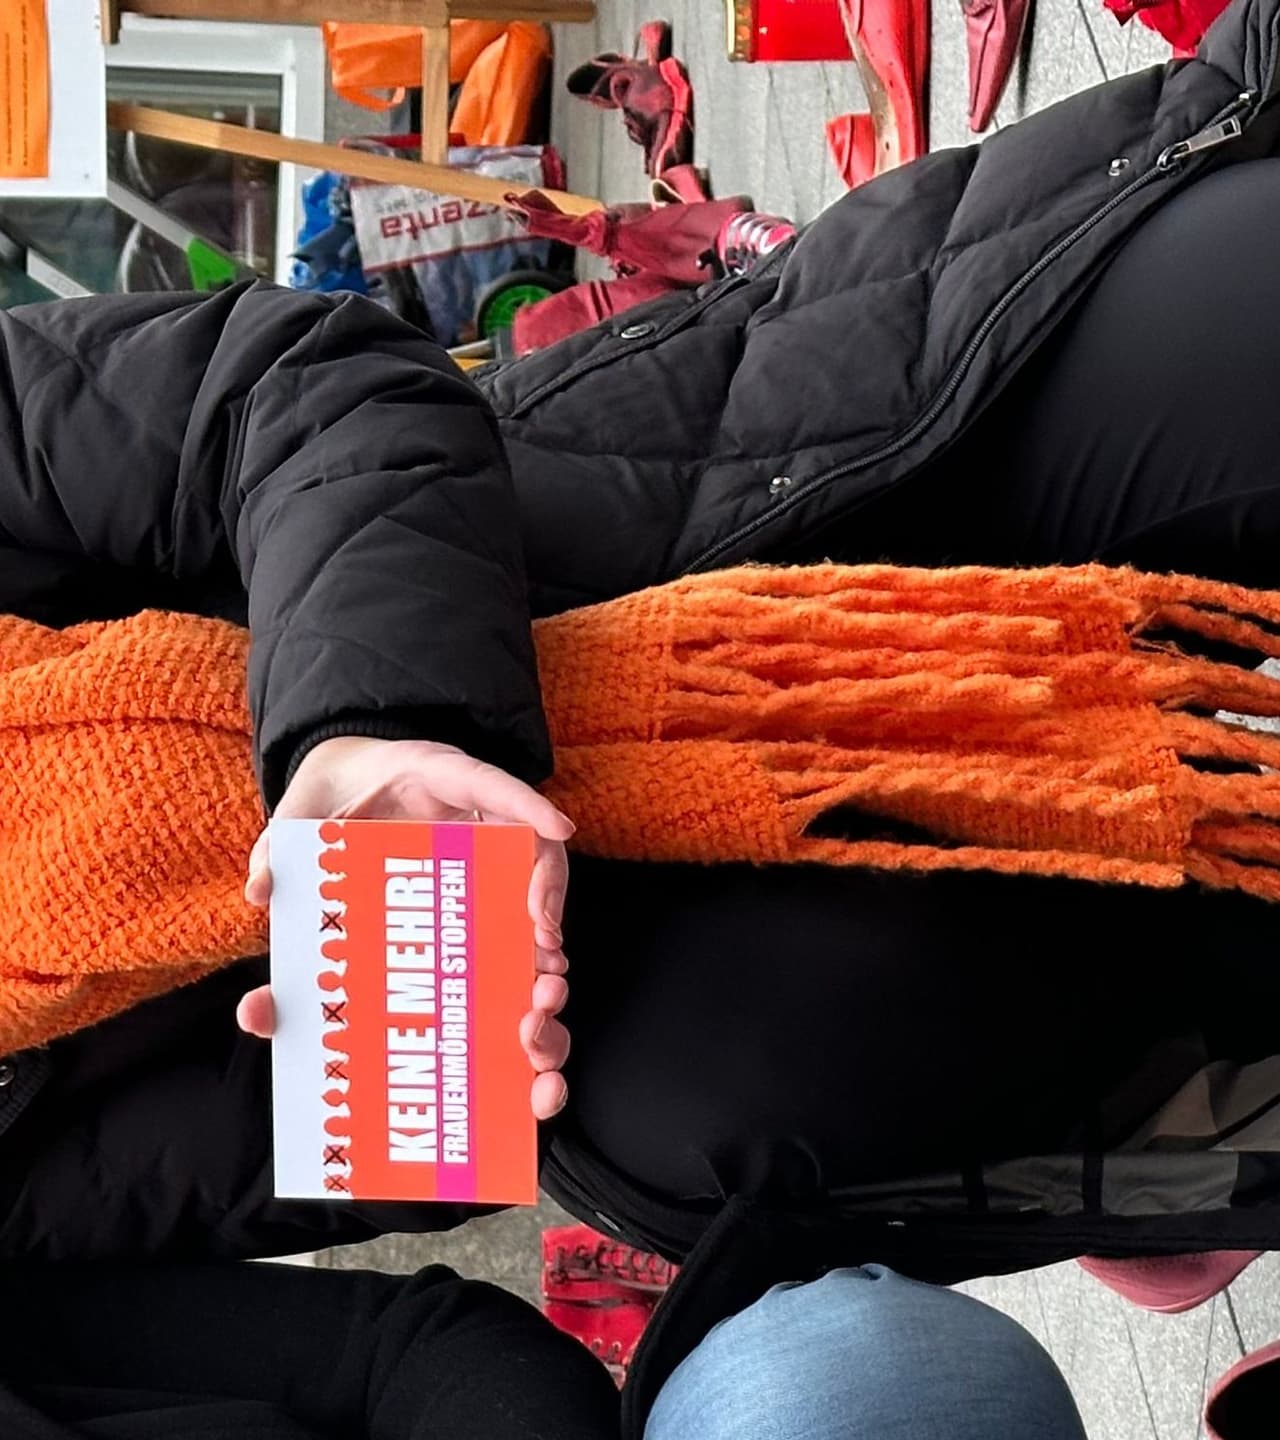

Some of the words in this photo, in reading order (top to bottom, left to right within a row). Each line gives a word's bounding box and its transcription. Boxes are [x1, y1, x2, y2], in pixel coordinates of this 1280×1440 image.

[385, 856, 436, 1015] MEHR!
[440, 859, 467, 973] STOPPEN!
[386, 1026, 438, 1163] KEINE
[438, 978, 469, 1164] FRAUENMÖRDER
